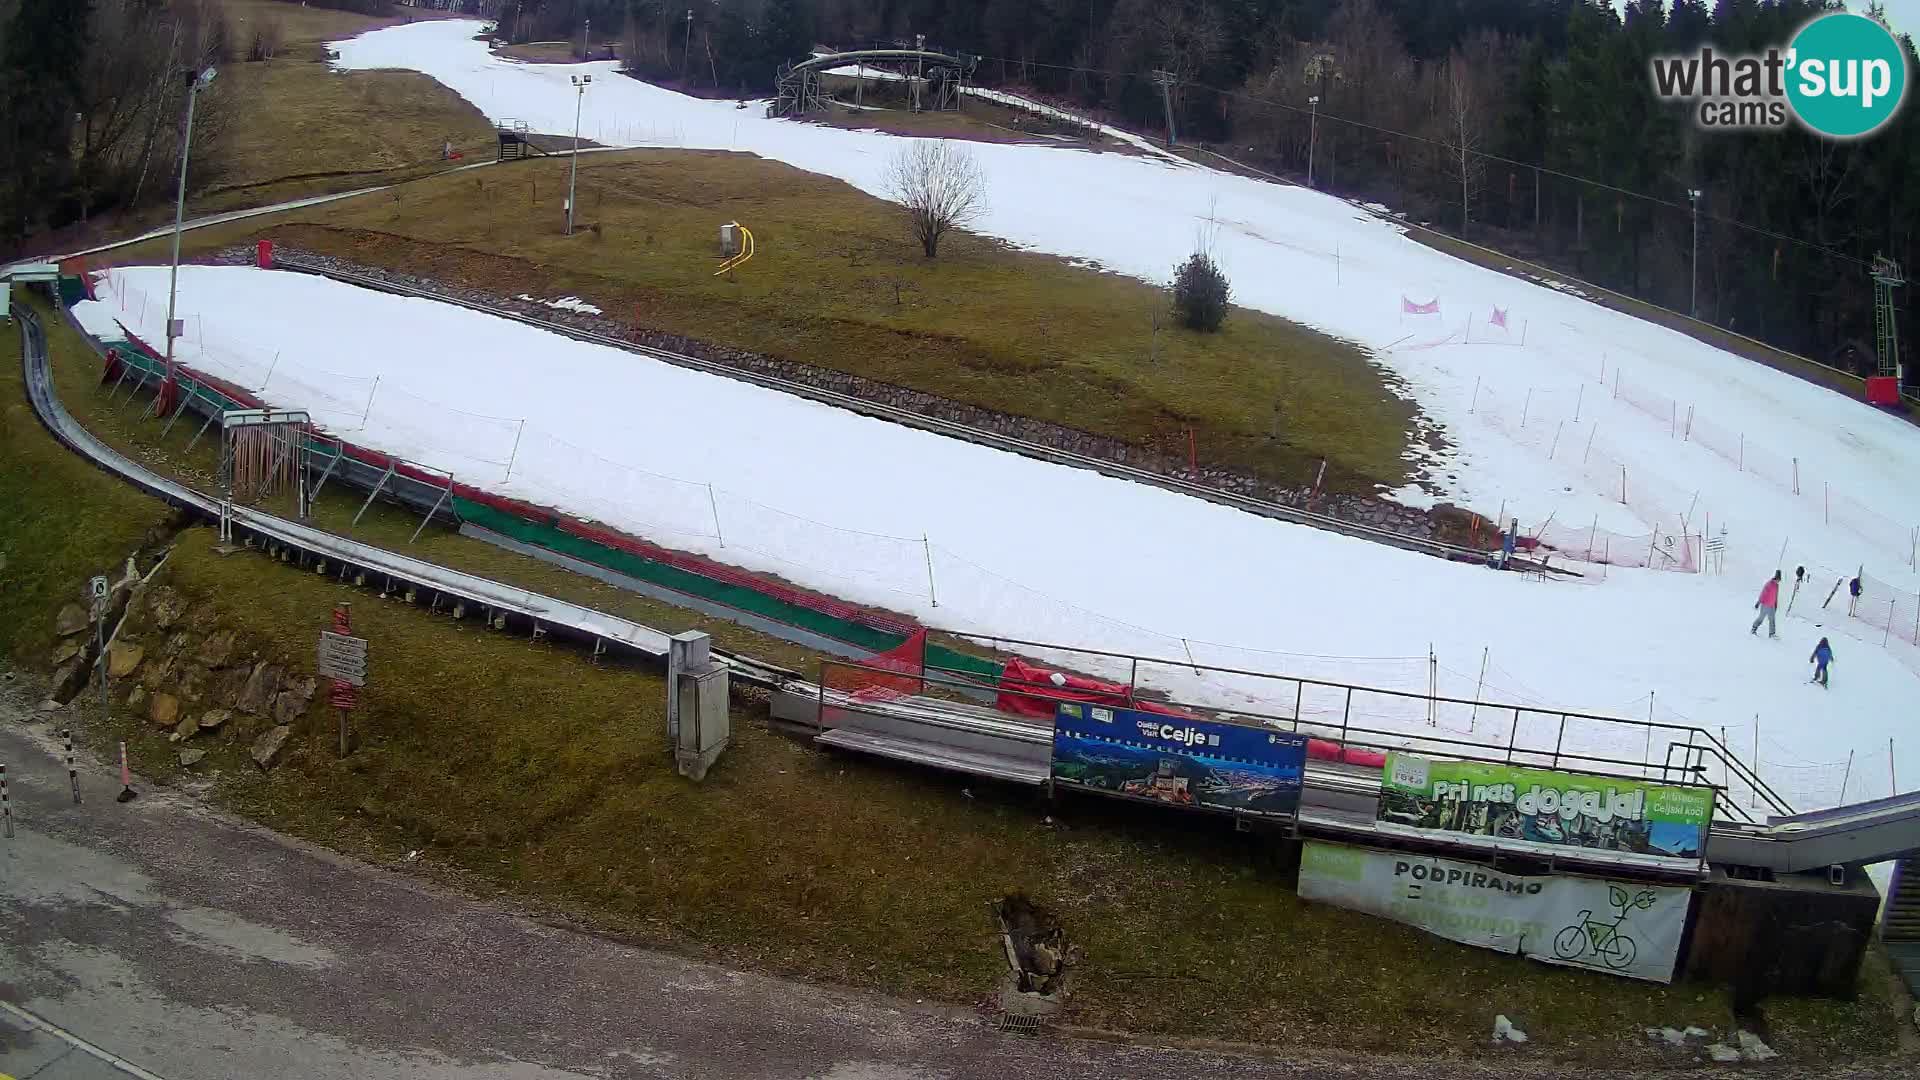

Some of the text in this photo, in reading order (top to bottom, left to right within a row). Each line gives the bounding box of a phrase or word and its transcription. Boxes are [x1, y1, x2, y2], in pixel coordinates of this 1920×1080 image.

[1160, 724, 1206, 747] Celje
[1473, 783, 1515, 802] nas
[1394, 860, 1544, 895] PODPIRAMO
